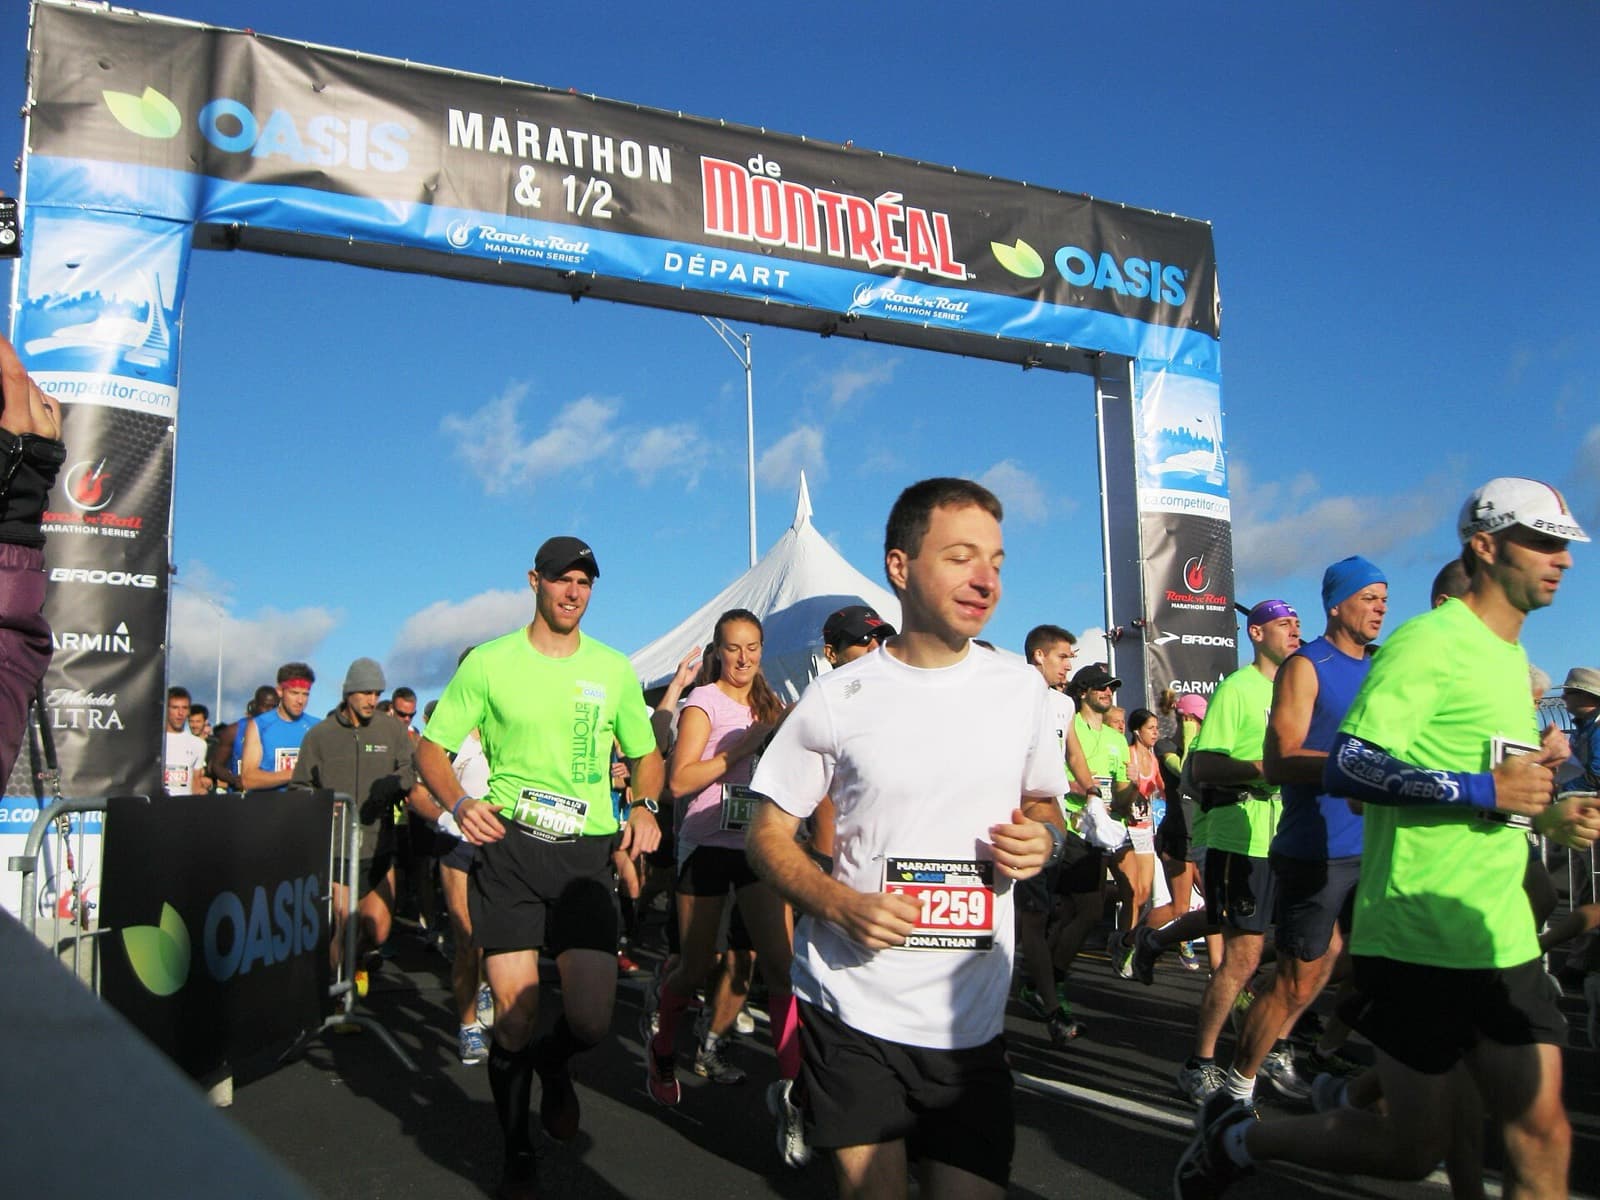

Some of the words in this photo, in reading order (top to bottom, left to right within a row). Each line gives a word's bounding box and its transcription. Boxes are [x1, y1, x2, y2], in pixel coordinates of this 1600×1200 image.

[199, 98, 411, 172] OASIS
[448, 108, 672, 184] MARATHON
[748, 154, 782, 178] de
[514, 164, 542, 209] &
[562, 174, 614, 219] 1/2
[484, 243, 543, 258] MARATHON
[546, 252, 580, 264] SERIES
[664, 252, 790, 289] DÉPART
[1054, 245, 1187, 307] OASIS
[885, 303, 931, 317] MARATHON
[933, 311, 960, 321] SERIES
[101, 527, 136, 539] SERIES
[51, 567, 157, 588] BROOKS
[1171, 602, 1205, 611] MARATHON
[1181, 634, 1235, 648] BROOKS
[1169, 680, 1218, 695] GARM
[51, 708, 124, 730] LTRA
[896, 861, 962, 873] MARATHON
[203, 873, 320, 983] OASIS
[904, 936, 977, 948] JONATHAN
